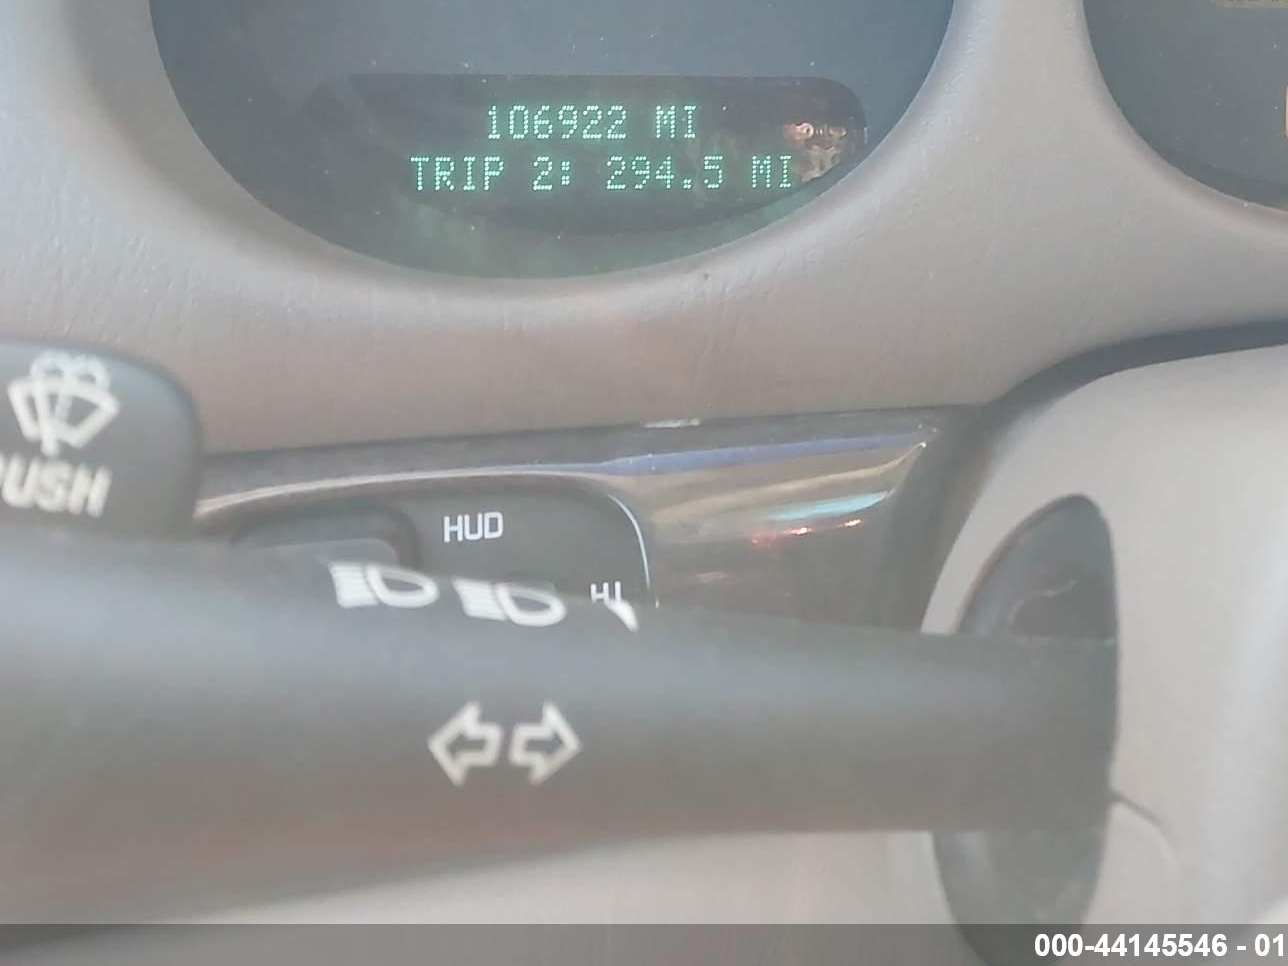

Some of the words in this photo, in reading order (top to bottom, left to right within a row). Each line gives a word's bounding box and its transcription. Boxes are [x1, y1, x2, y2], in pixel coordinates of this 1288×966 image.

[488, 105, 627, 140] 106922
[655, 105, 697, 139] MI
[410, 156, 504, 191] TRIP
[532, 156, 570, 191] 2:
[606, 155, 724, 190] 294.5
[751, 155, 792, 188] MI
[443, 511, 504, 543] HUD
